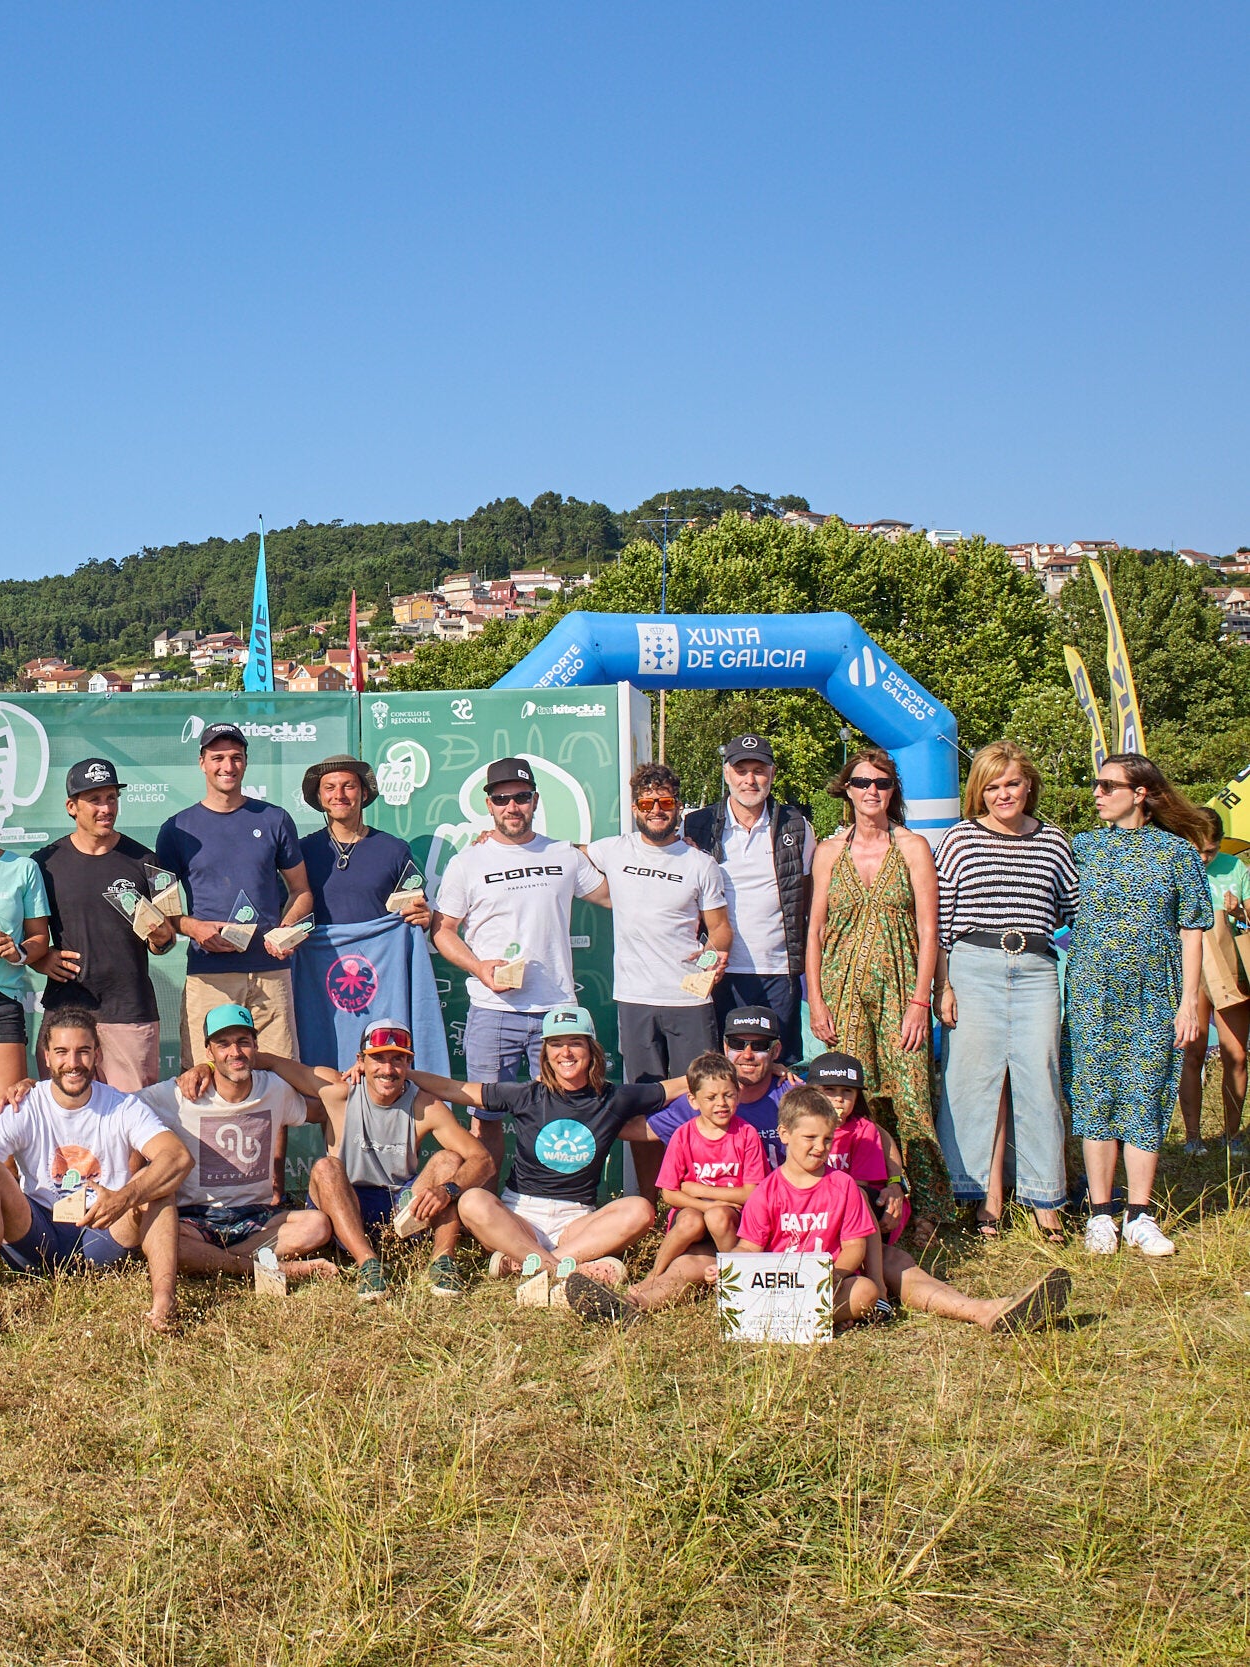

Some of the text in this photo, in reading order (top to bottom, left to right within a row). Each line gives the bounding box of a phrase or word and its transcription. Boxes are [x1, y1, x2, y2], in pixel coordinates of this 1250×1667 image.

[686, 627, 761, 646] XUNTA
[687, 649, 806, 668] DE GALICIA
[555, 658, 584, 688] LEGO
[882, 680, 925, 720] GALEGO
[888, 671, 936, 717] DEPORTE
[237, 722, 317, 737] kiteclub
[127, 784, 169, 792] DEPORTE
[379, 781, 411, 792] JULIO
[127, 793, 166, 802] GALEGO
[751, 1272, 805, 1289] ABRIL
